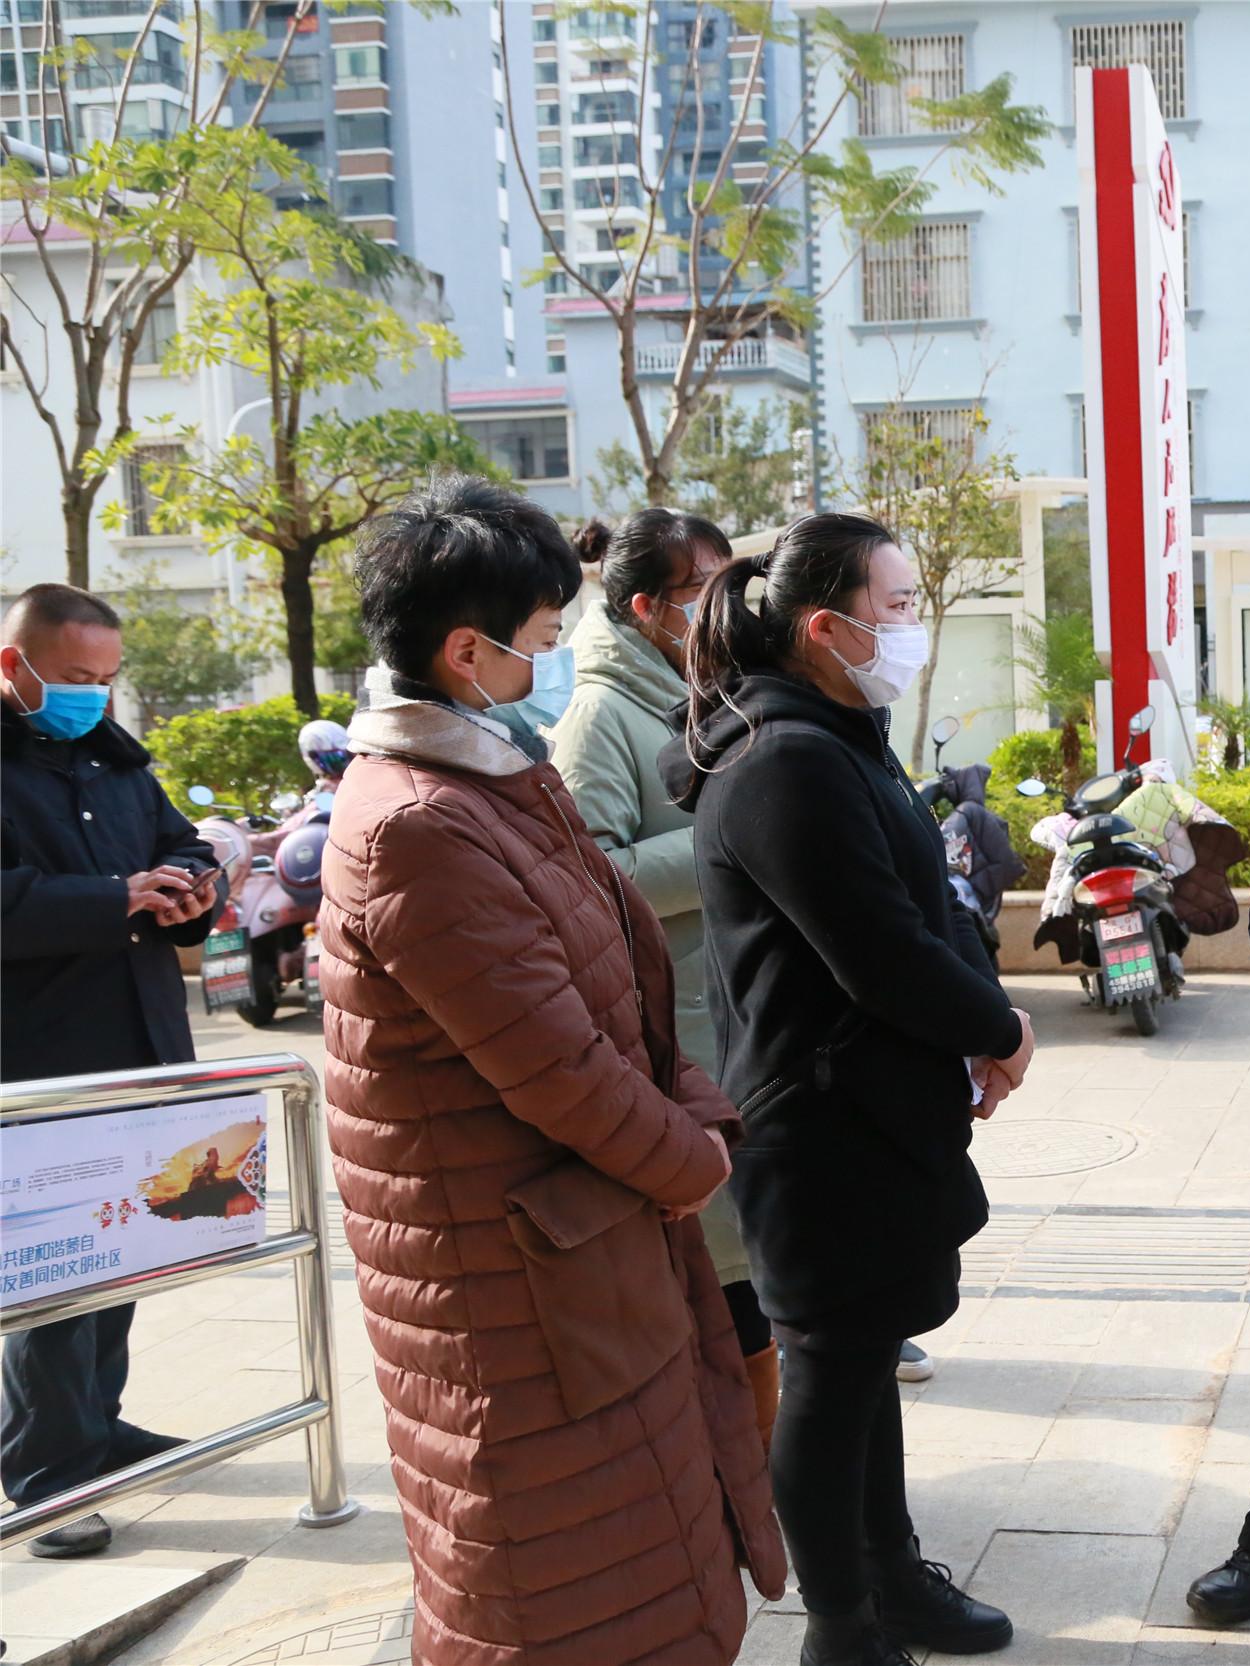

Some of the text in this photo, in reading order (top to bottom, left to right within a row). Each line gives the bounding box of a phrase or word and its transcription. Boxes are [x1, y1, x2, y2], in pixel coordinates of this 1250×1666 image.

[0, 1235, 94, 1269] 共建和谐蒙自
[0, 1248, 121, 1293] 友善同创文明社区
